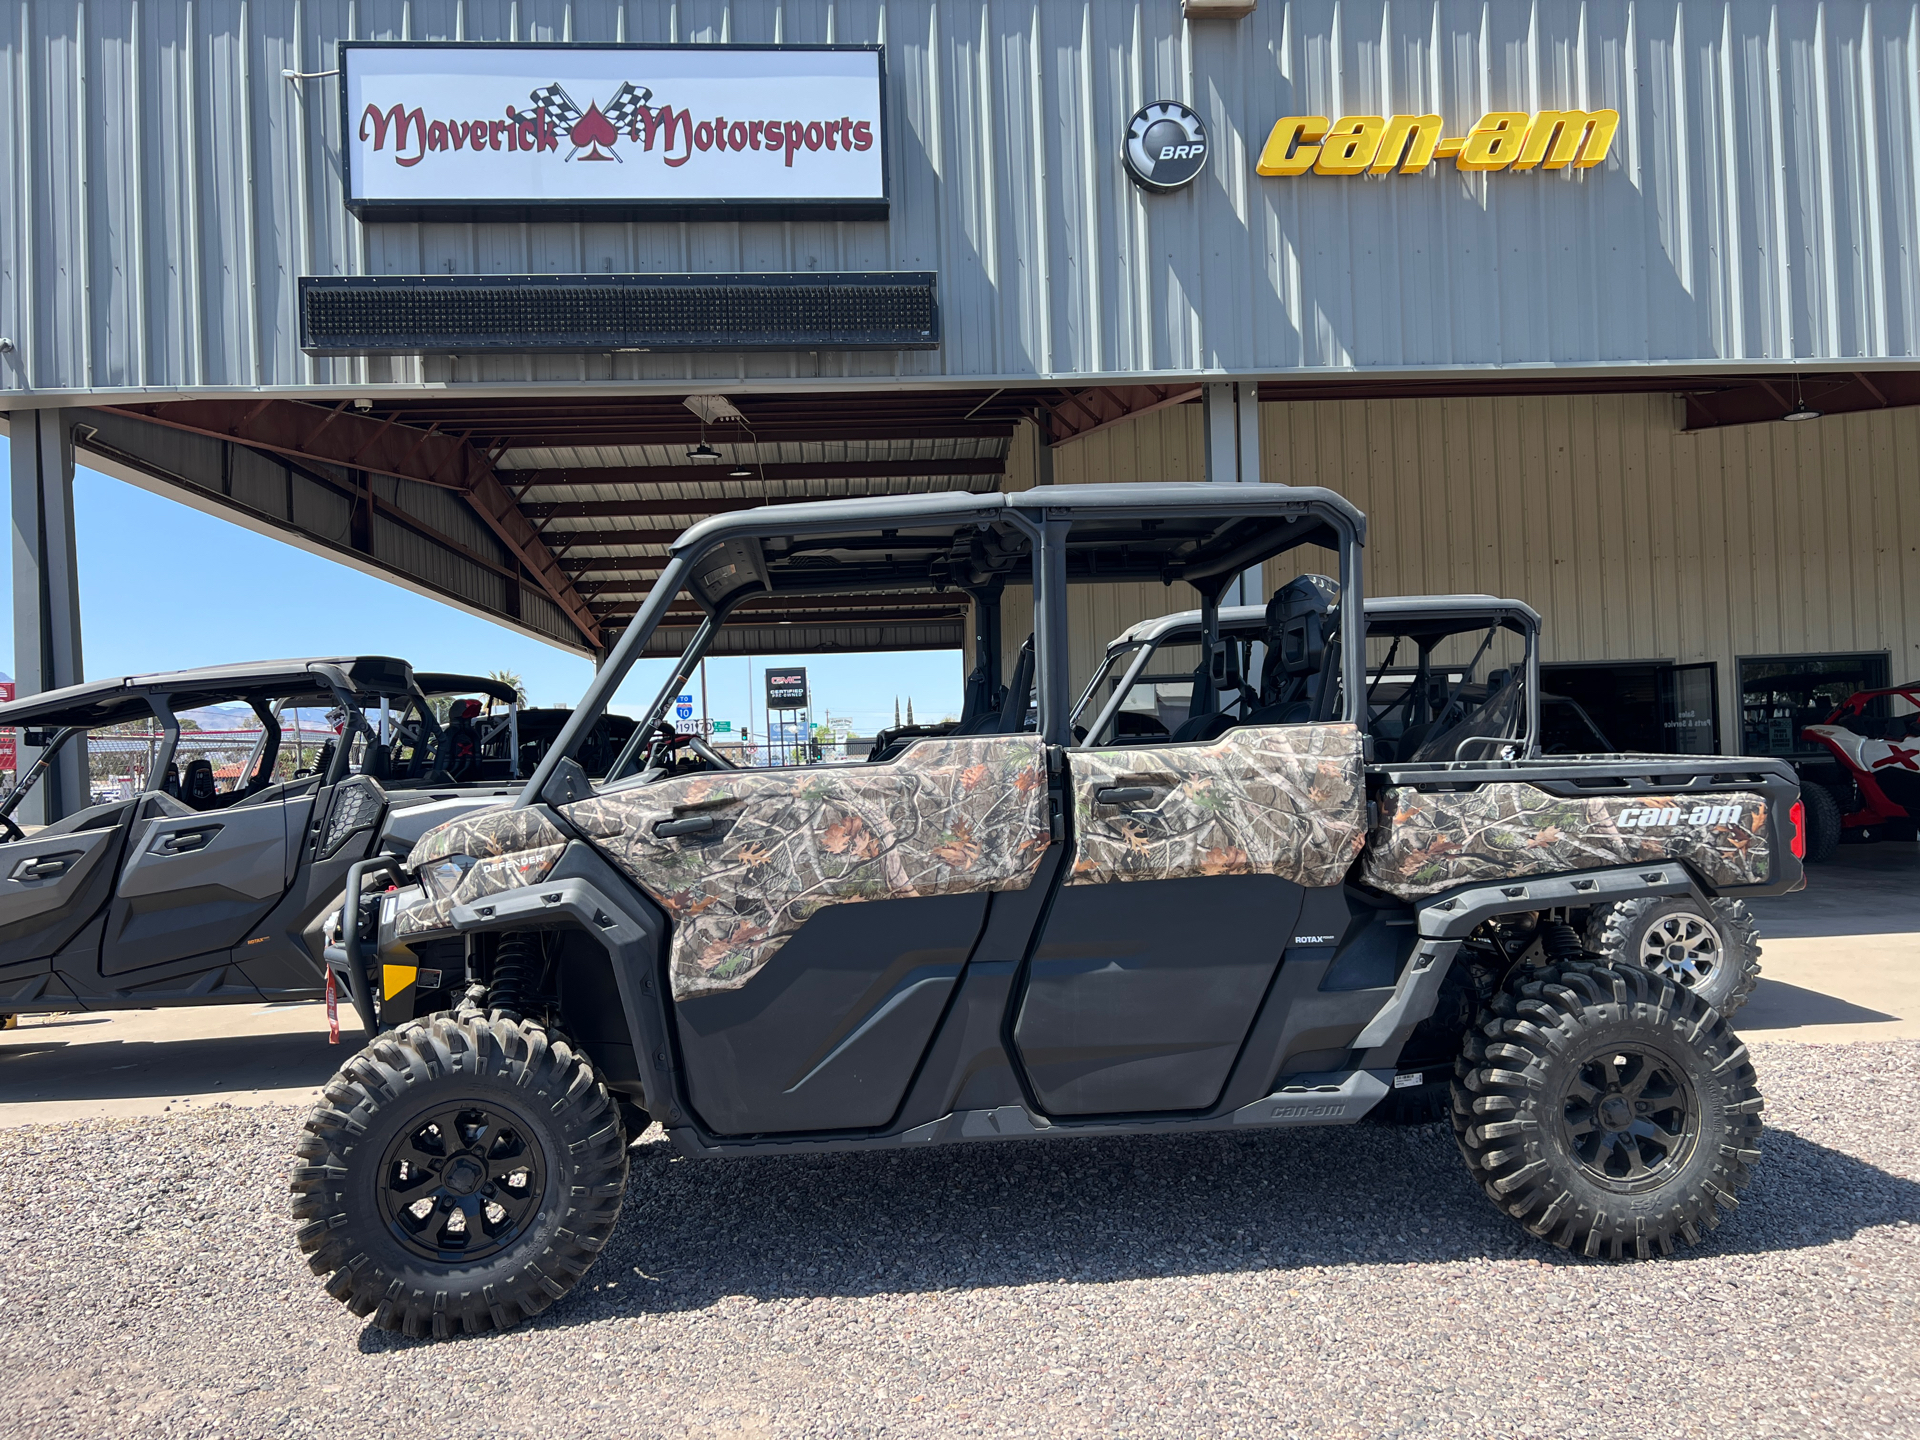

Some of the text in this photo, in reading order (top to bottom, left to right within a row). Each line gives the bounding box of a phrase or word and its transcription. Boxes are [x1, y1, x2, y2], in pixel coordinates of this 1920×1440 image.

[359, 102, 873, 168] Maverick Motorsports
[1256, 108, 1620, 177] can-am
[1158, 144, 1204, 161] BRP
[771, 676, 802, 684] GMC
[679, 709, 690, 718] 10
[680, 723, 694, 733] 191
[1617, 804, 1743, 828] can-am
[483, 854, 544, 873] DEFENDER
[1294, 935, 1323, 944] ROTAX
[1271, 1104, 1346, 1119] can-am
